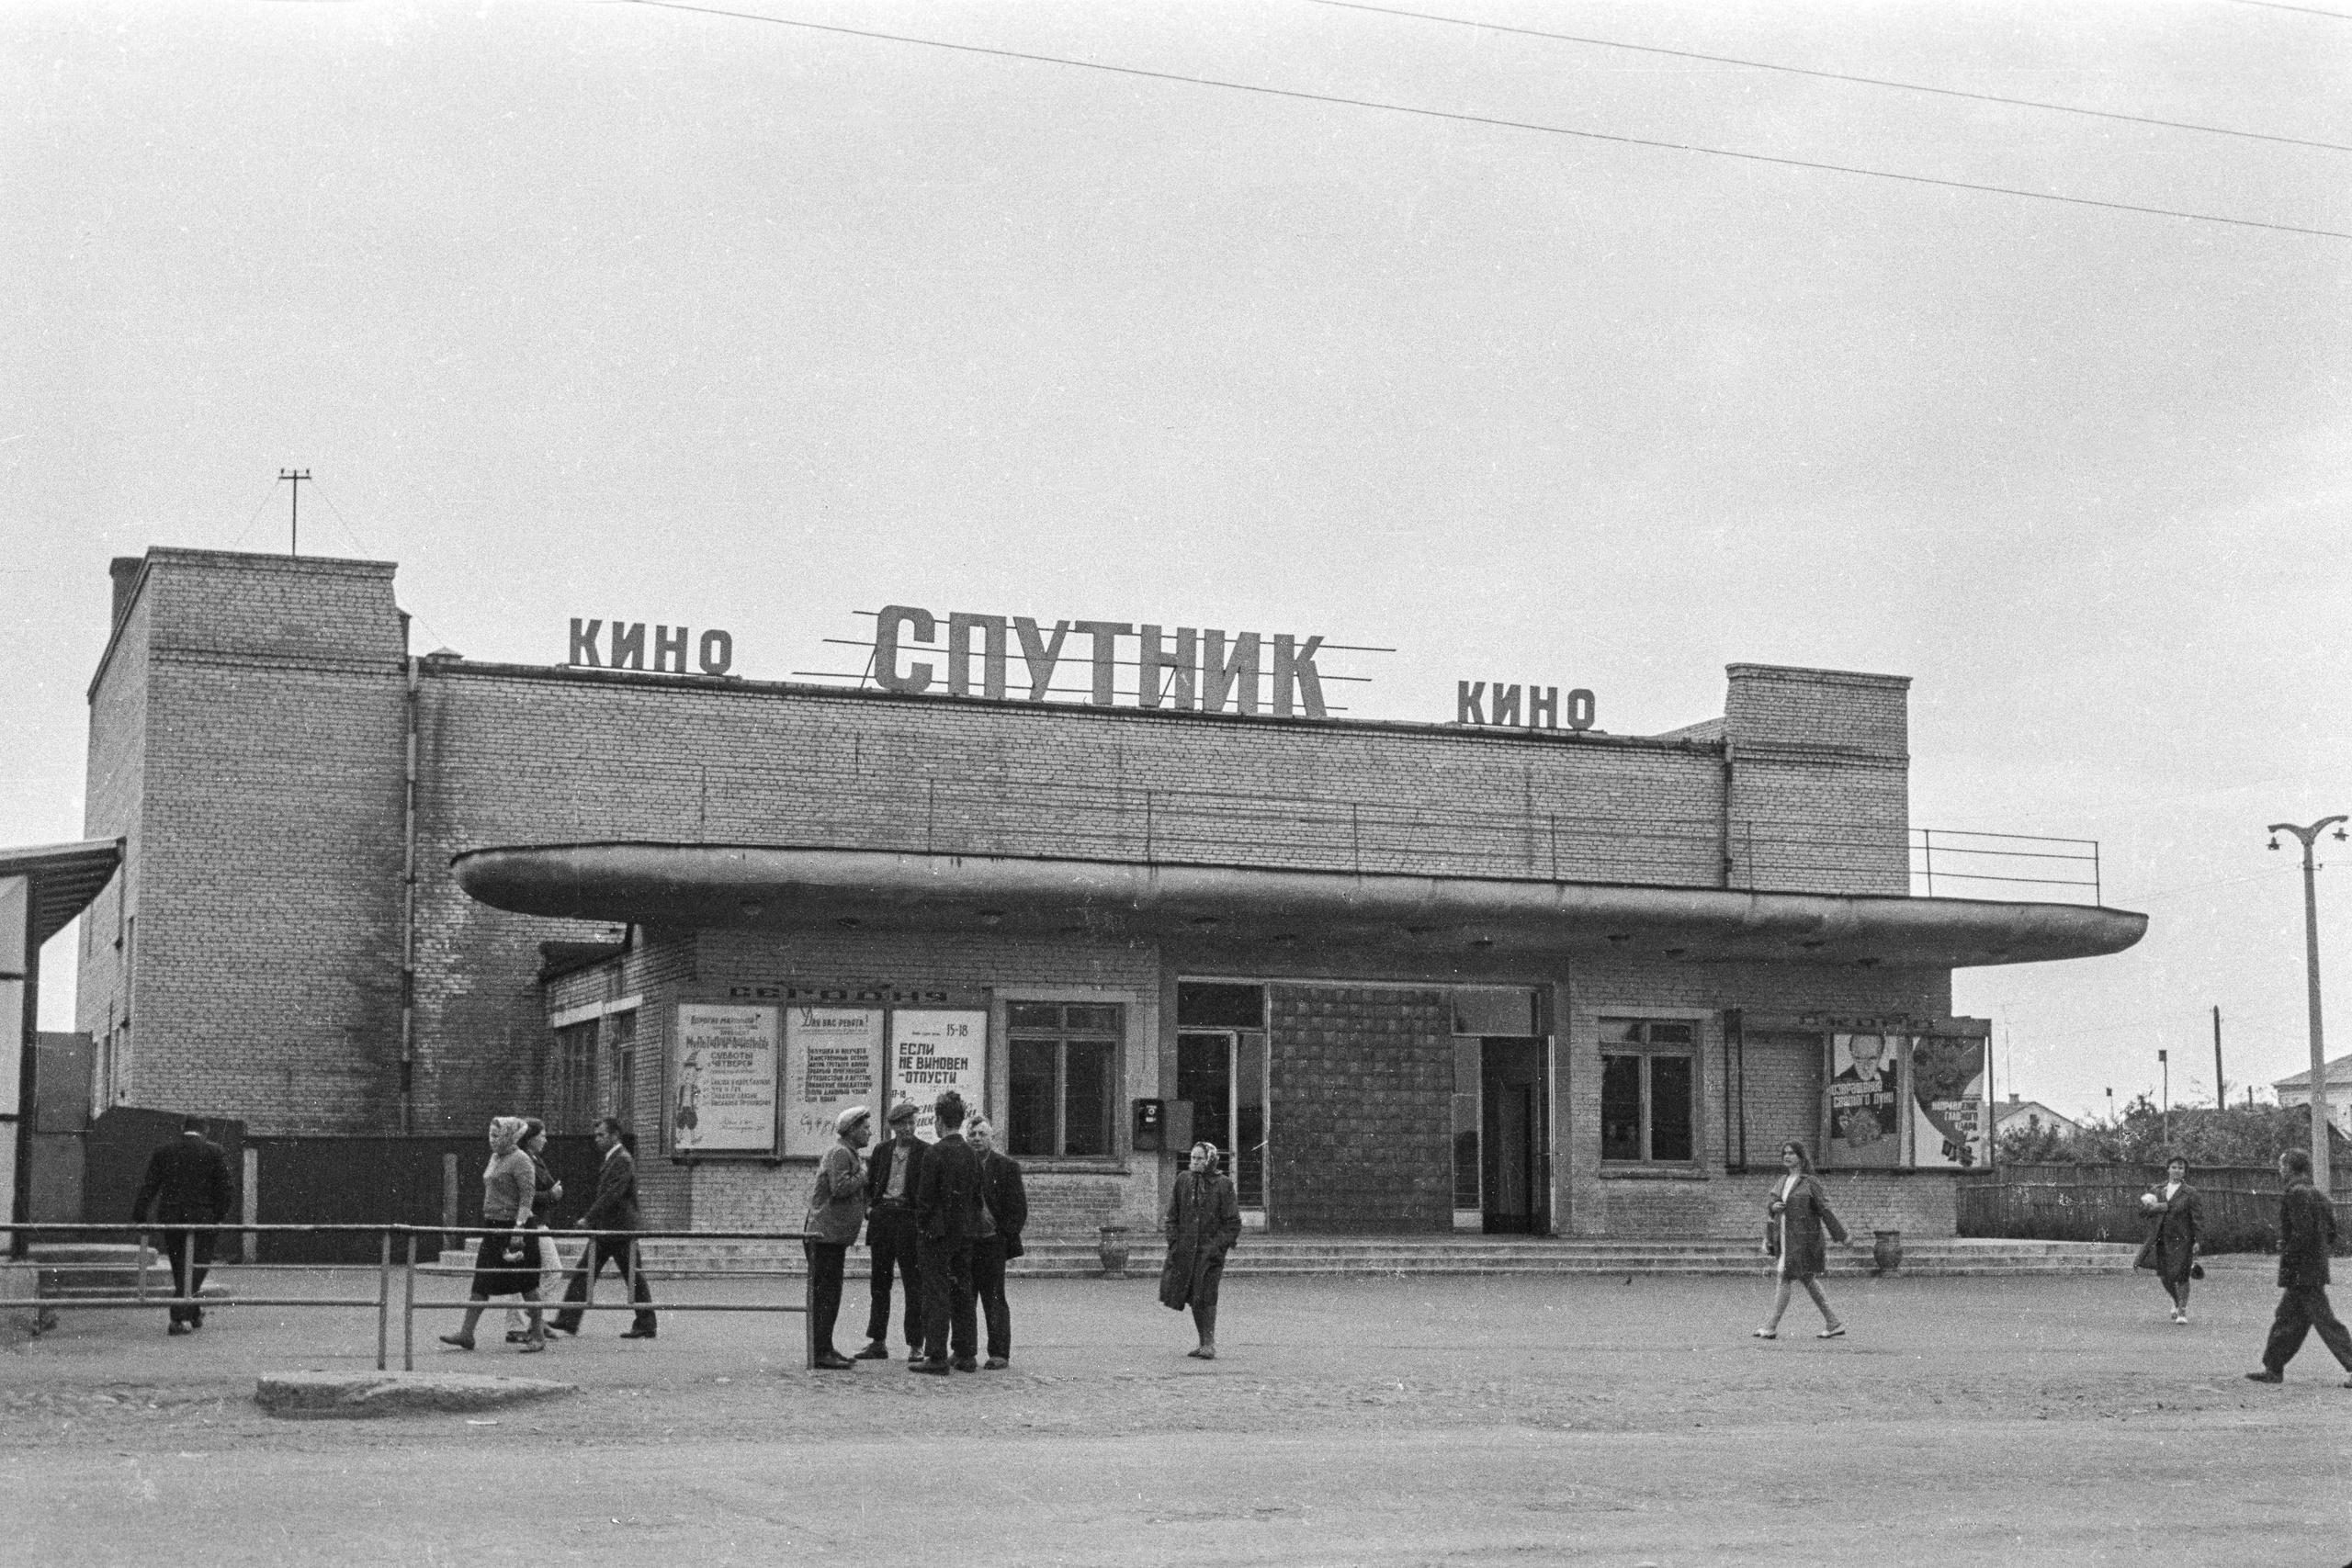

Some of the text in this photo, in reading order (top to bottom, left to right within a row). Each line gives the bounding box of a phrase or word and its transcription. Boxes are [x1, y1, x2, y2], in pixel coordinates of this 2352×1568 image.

[570, 617, 732, 676] КИНО
[876, 604, 1327, 718] СПУТНИК
[1458, 681, 1595, 731] КИНО
[730, 987, 947, 1001] СЕГОДНЯ
[946, 1024, 968, 1037] 15-18
[899, 1043, 934, 1055] ЕСЛИ
[899, 1056, 968, 1070] НЕ ВИНОВЕН
